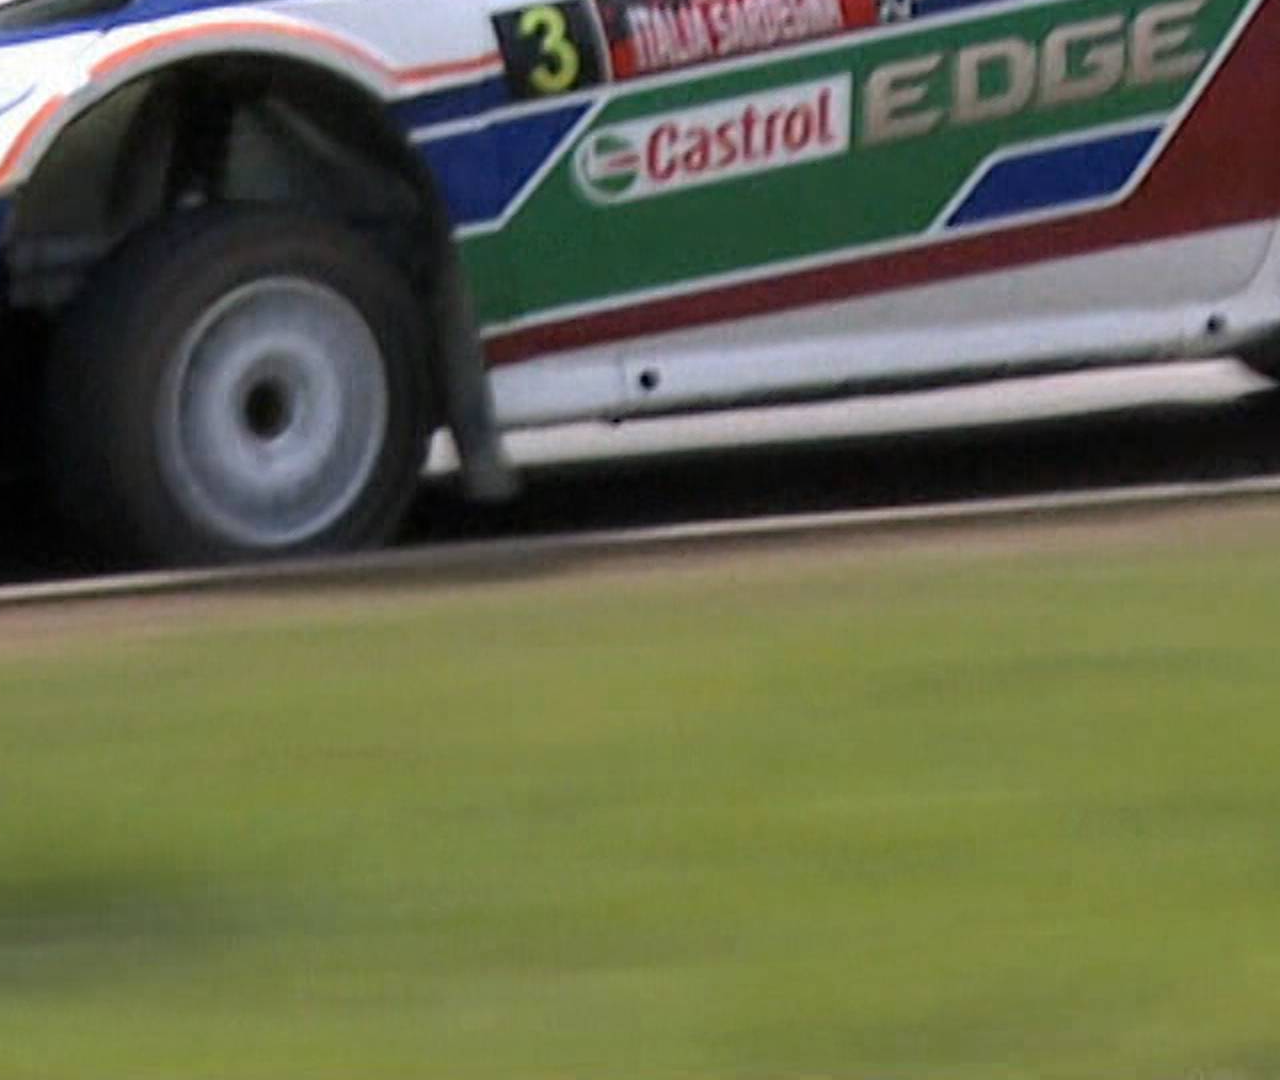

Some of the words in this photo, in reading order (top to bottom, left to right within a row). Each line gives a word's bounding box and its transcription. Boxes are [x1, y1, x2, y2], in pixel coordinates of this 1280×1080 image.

[518, 3, 581, 94] 3
[626, 0, 715, 69] ITALIA
[646, 86, 837, 182] Castrol
